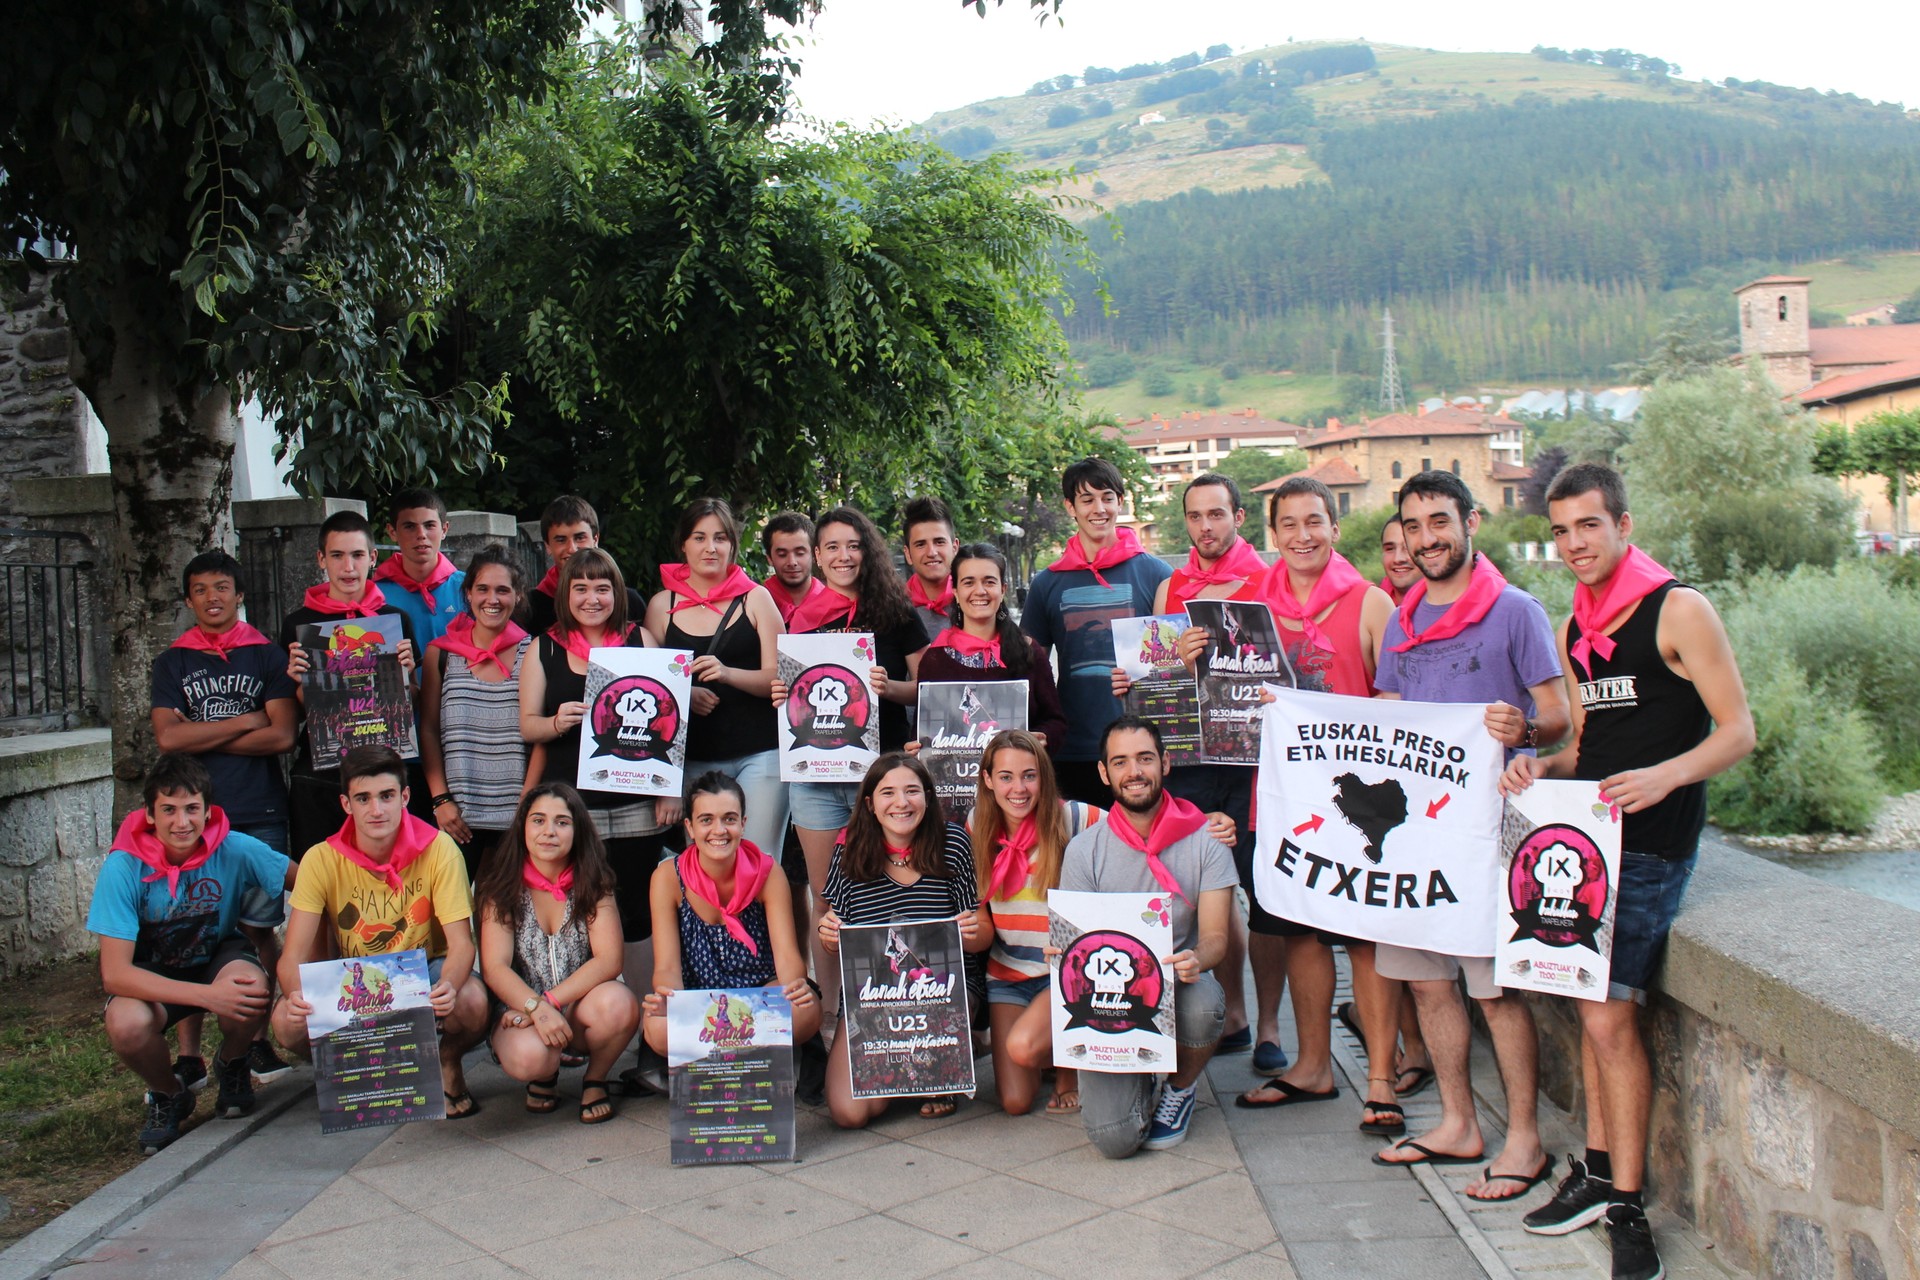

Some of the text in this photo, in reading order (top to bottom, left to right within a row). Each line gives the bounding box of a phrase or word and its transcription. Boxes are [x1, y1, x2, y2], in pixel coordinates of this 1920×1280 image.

[1231, 685, 1261, 701] U23
[1209, 709, 1230, 717] 19:30
[931, 723, 978, 749] danak
[1297, 722, 1466, 764] EUSKAL PRESO
[610, 770, 646, 778] ABUZTUAK
[956, 763, 979, 778] U2
[1286, 744, 1471, 789] ETA IHESLARIAK
[935, 785, 955, 793] 9:30
[1274, 837, 1459, 910] ETXERA
[1533, 960, 1571, 973] ABUZTUAK
[859, 970, 908, 1001] danak
[355, 1005, 393, 1015] ARROXA
[888, 1014, 928, 1032] U23
[716, 1040, 753, 1048] ARROXA
[862, 1041, 889, 1050] 19:30
